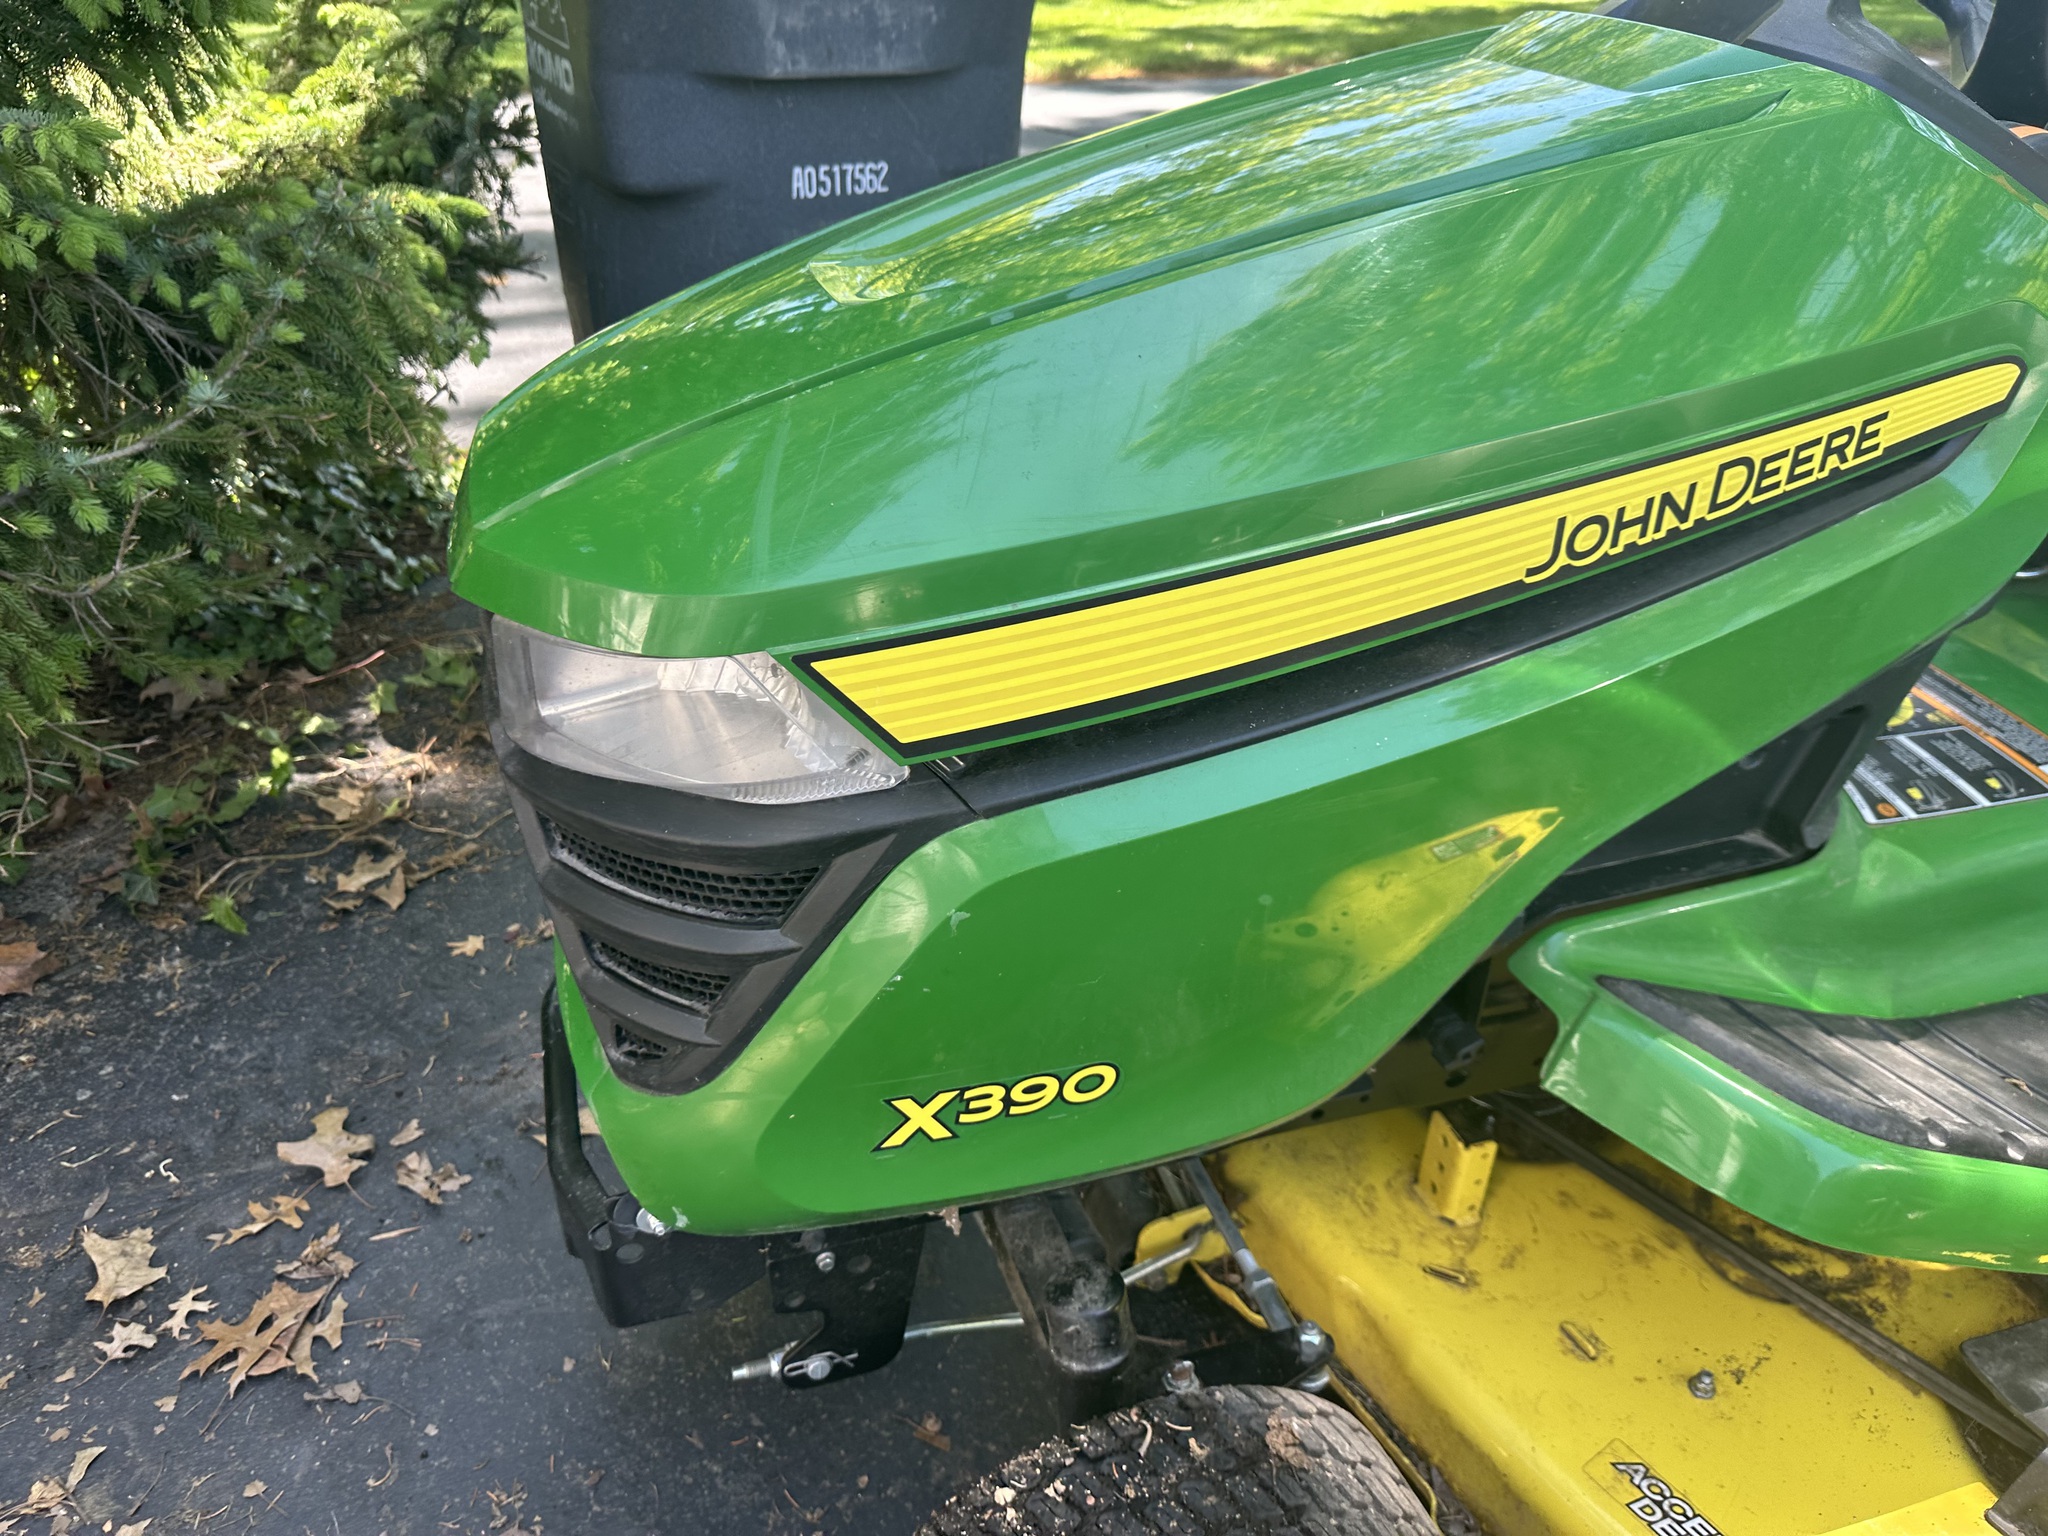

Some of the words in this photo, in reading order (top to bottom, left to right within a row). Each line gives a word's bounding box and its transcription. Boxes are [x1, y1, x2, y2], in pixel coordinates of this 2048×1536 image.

[526, 33, 575, 96] KOMO
[791, 160, 890, 200] A0517562
[1524, 481, 1698, 579] JOHN
[1708, 410, 1890, 514] DEERE
[869, 1061, 1122, 1153] X390
[1610, 1461, 1725, 1536] ACCE
[1625, 1495, 1692, 1536] DE
